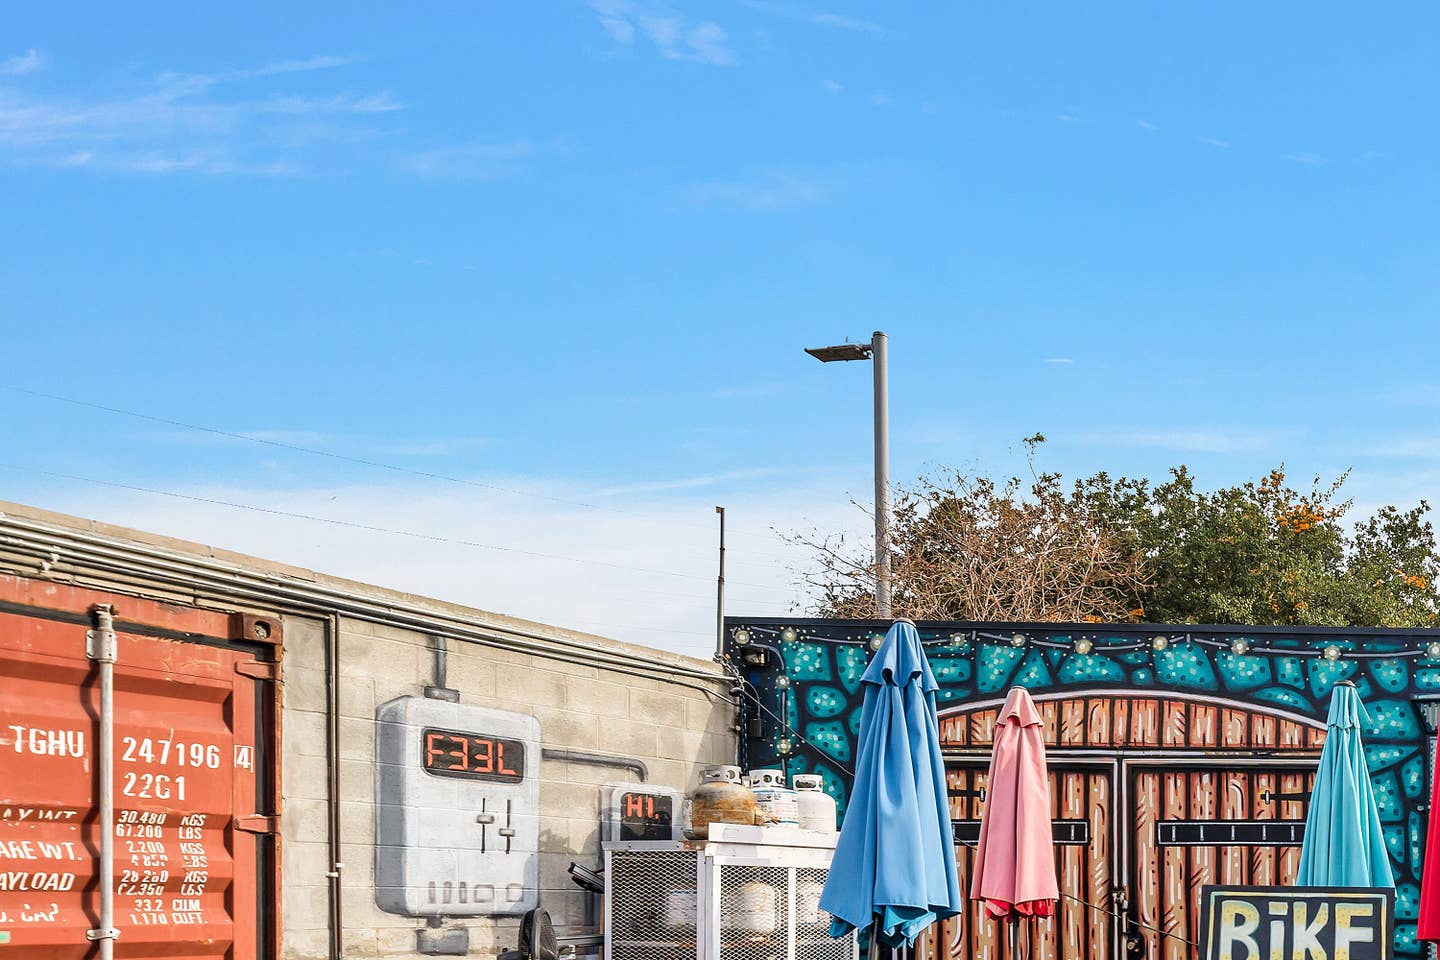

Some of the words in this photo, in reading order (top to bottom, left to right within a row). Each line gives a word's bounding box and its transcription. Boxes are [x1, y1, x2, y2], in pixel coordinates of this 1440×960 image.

[8, 725, 84, 757] TGHU
[122, 736, 220, 769] 247196
[236, 746, 251, 768] 4
[181, 814, 206, 826] KGS
[116, 824, 162, 838] 67.200
[178, 826, 202, 839] LBS
[0, 840, 37, 860] ARE
[125, 841, 165, 853] 2.200
[179, 842, 205, 855] KGS
[0, 872, 75, 891] AYLOAD
